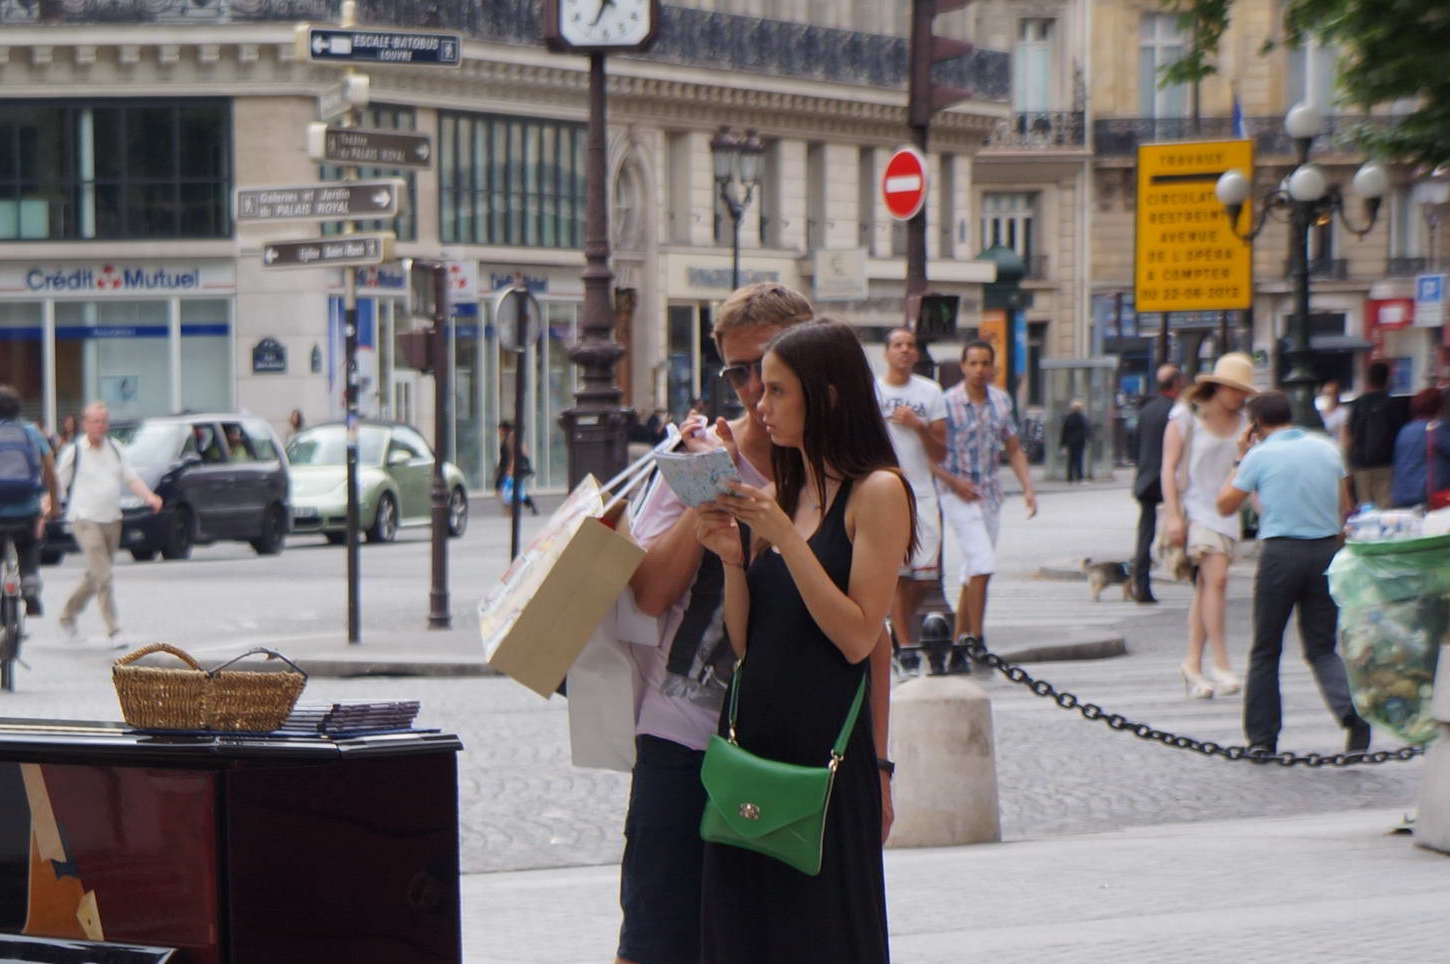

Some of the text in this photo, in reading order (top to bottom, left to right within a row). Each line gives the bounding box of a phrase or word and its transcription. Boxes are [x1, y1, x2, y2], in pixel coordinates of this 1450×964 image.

[380, 49, 413, 61] LOUVRE
[351, 147, 378, 160] PALAIS
[380, 149, 406, 162] ROYAL
[1159, 153, 1224, 167] TRAVAUX
[260, 189, 351, 203] Galeries et Jardin
[259, 201, 350, 217] du PALAIS ROYAL
[1159, 230, 1219, 243] AVENUE
[1147, 251, 1166, 263] DE
[25, 267, 200, 290] Crédit Mutuel
[1162, 268, 1231, 281] COMPTER
[1140, 289, 1158, 301] DU
